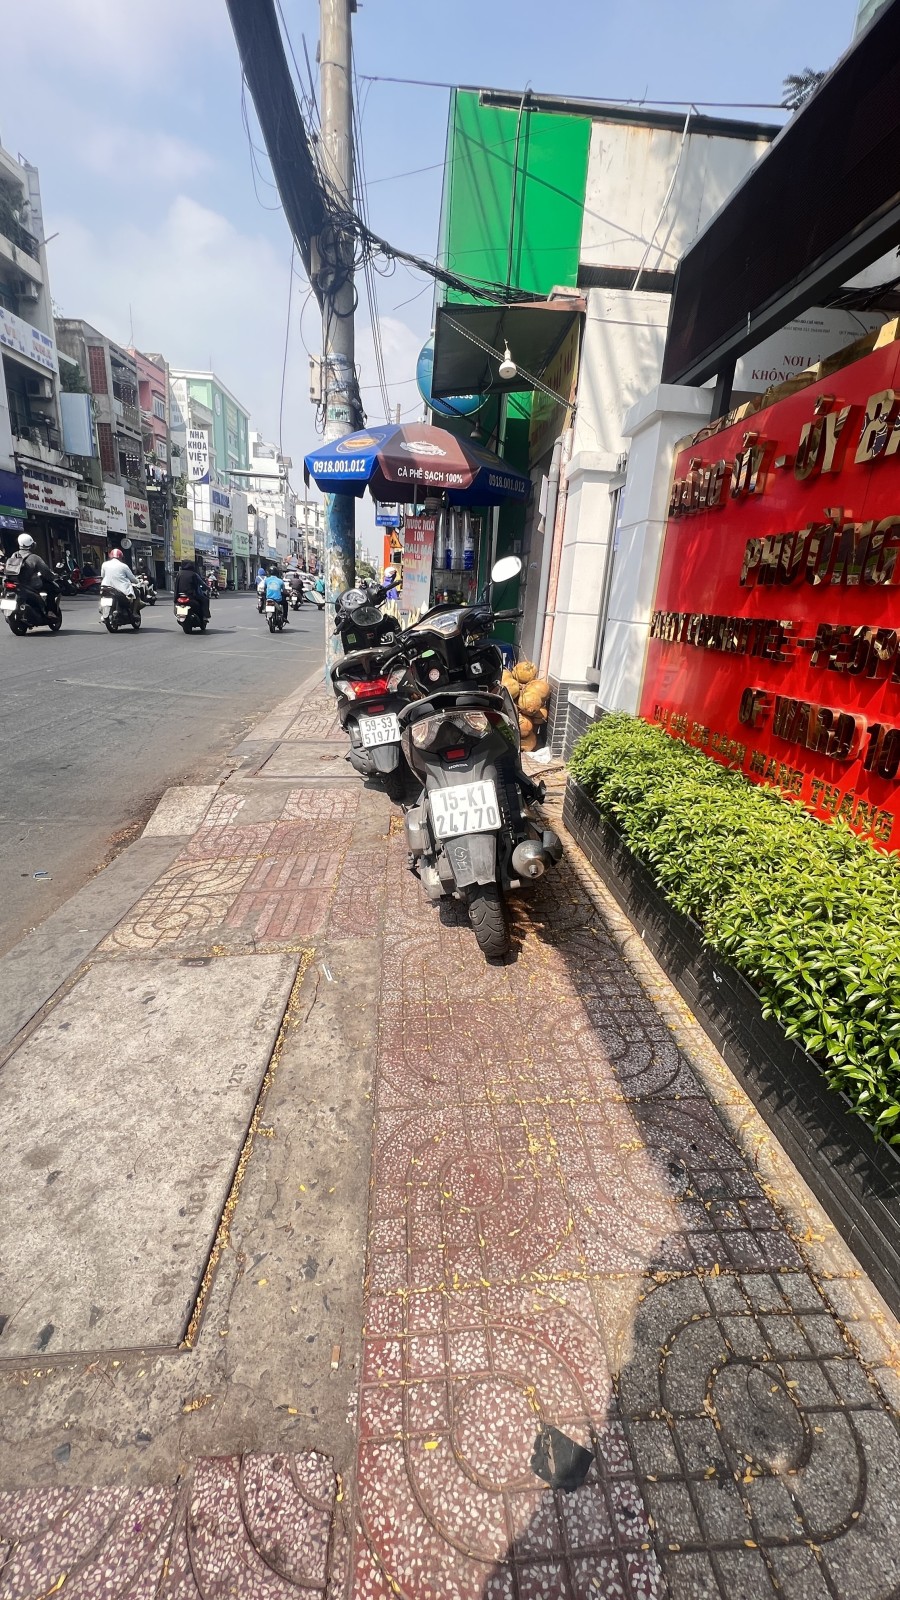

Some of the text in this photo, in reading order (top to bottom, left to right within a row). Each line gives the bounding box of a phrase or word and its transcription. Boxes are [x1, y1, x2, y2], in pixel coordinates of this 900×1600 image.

[783, 355, 804, 367] NƠI
[189, 430, 204, 439] NHA
[187, 440, 207, 450] KHOA
[730, 432, 767, 499] ỦY
[795, 394, 852, 481] ỦY
[855, 388, 900, 463] B
[188, 450, 207, 464] VIỆT
[192, 465, 205, 476] MỸ
[313, 460, 365, 473] 0918.001.012
[397, 466, 463, 484] CÀ PHÊ SẠCH 100%
[488, 473, 525, 493] 0918.001.012
[404, 543, 419, 554] RAU
[739, 508, 900, 587] PHƯỜNG
[650, 611, 685, 642] PARTY
[687, 613, 796, 662] COMMITTEE
[810, 623, 900, 680] PEOP
[364, 716, 393, 732] 59-S3
[364, 728, 397, 745] 519.77
[738, 687, 900, 780] OF WARD 10
[440, 785, 487, 812] 15-K1
[436, 806, 497, 835] 247.70
